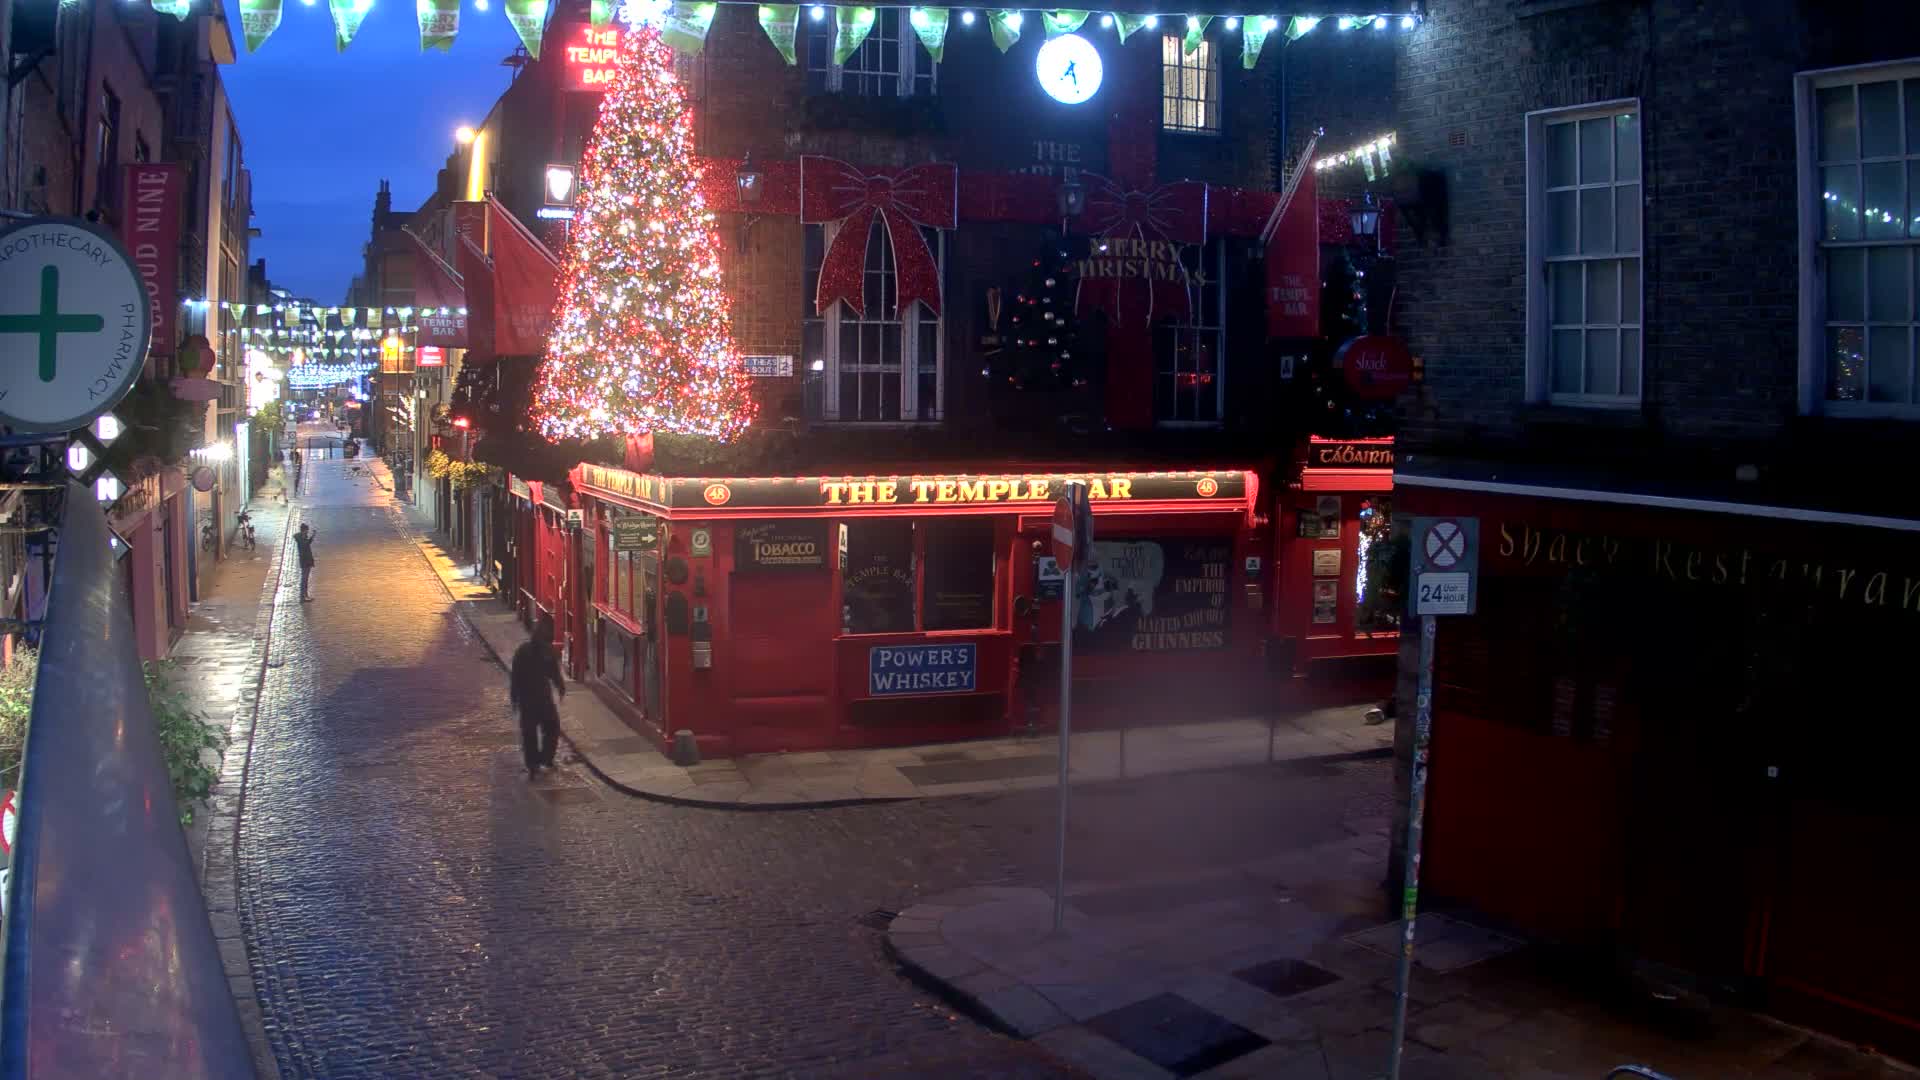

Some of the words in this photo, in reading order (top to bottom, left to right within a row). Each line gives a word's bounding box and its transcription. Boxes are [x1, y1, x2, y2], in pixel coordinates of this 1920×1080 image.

[584, 29, 617, 46] THE
[136, 171, 169, 232] NINE
[1089, 238, 1182, 261] MERRY
[423, 318, 464, 328] TEMPLE
[433, 328, 455, 336] BAR
[87, 303, 135, 400] PHARMACY
[708, 487, 726, 500] 48
[821, 481, 898, 504] THE
[911, 479, 1050, 502] TEMPLE
[1064, 478, 1132, 499] AR
[1199, 481, 1213, 493] 48
[752, 541, 816, 561] TOBACCO
[1421, 584, 1442, 602] 24
[1132, 632, 1224, 650] GUINNESS
[880, 648, 969, 668] POWER'S
[873, 671, 973, 691] WHISKEY
